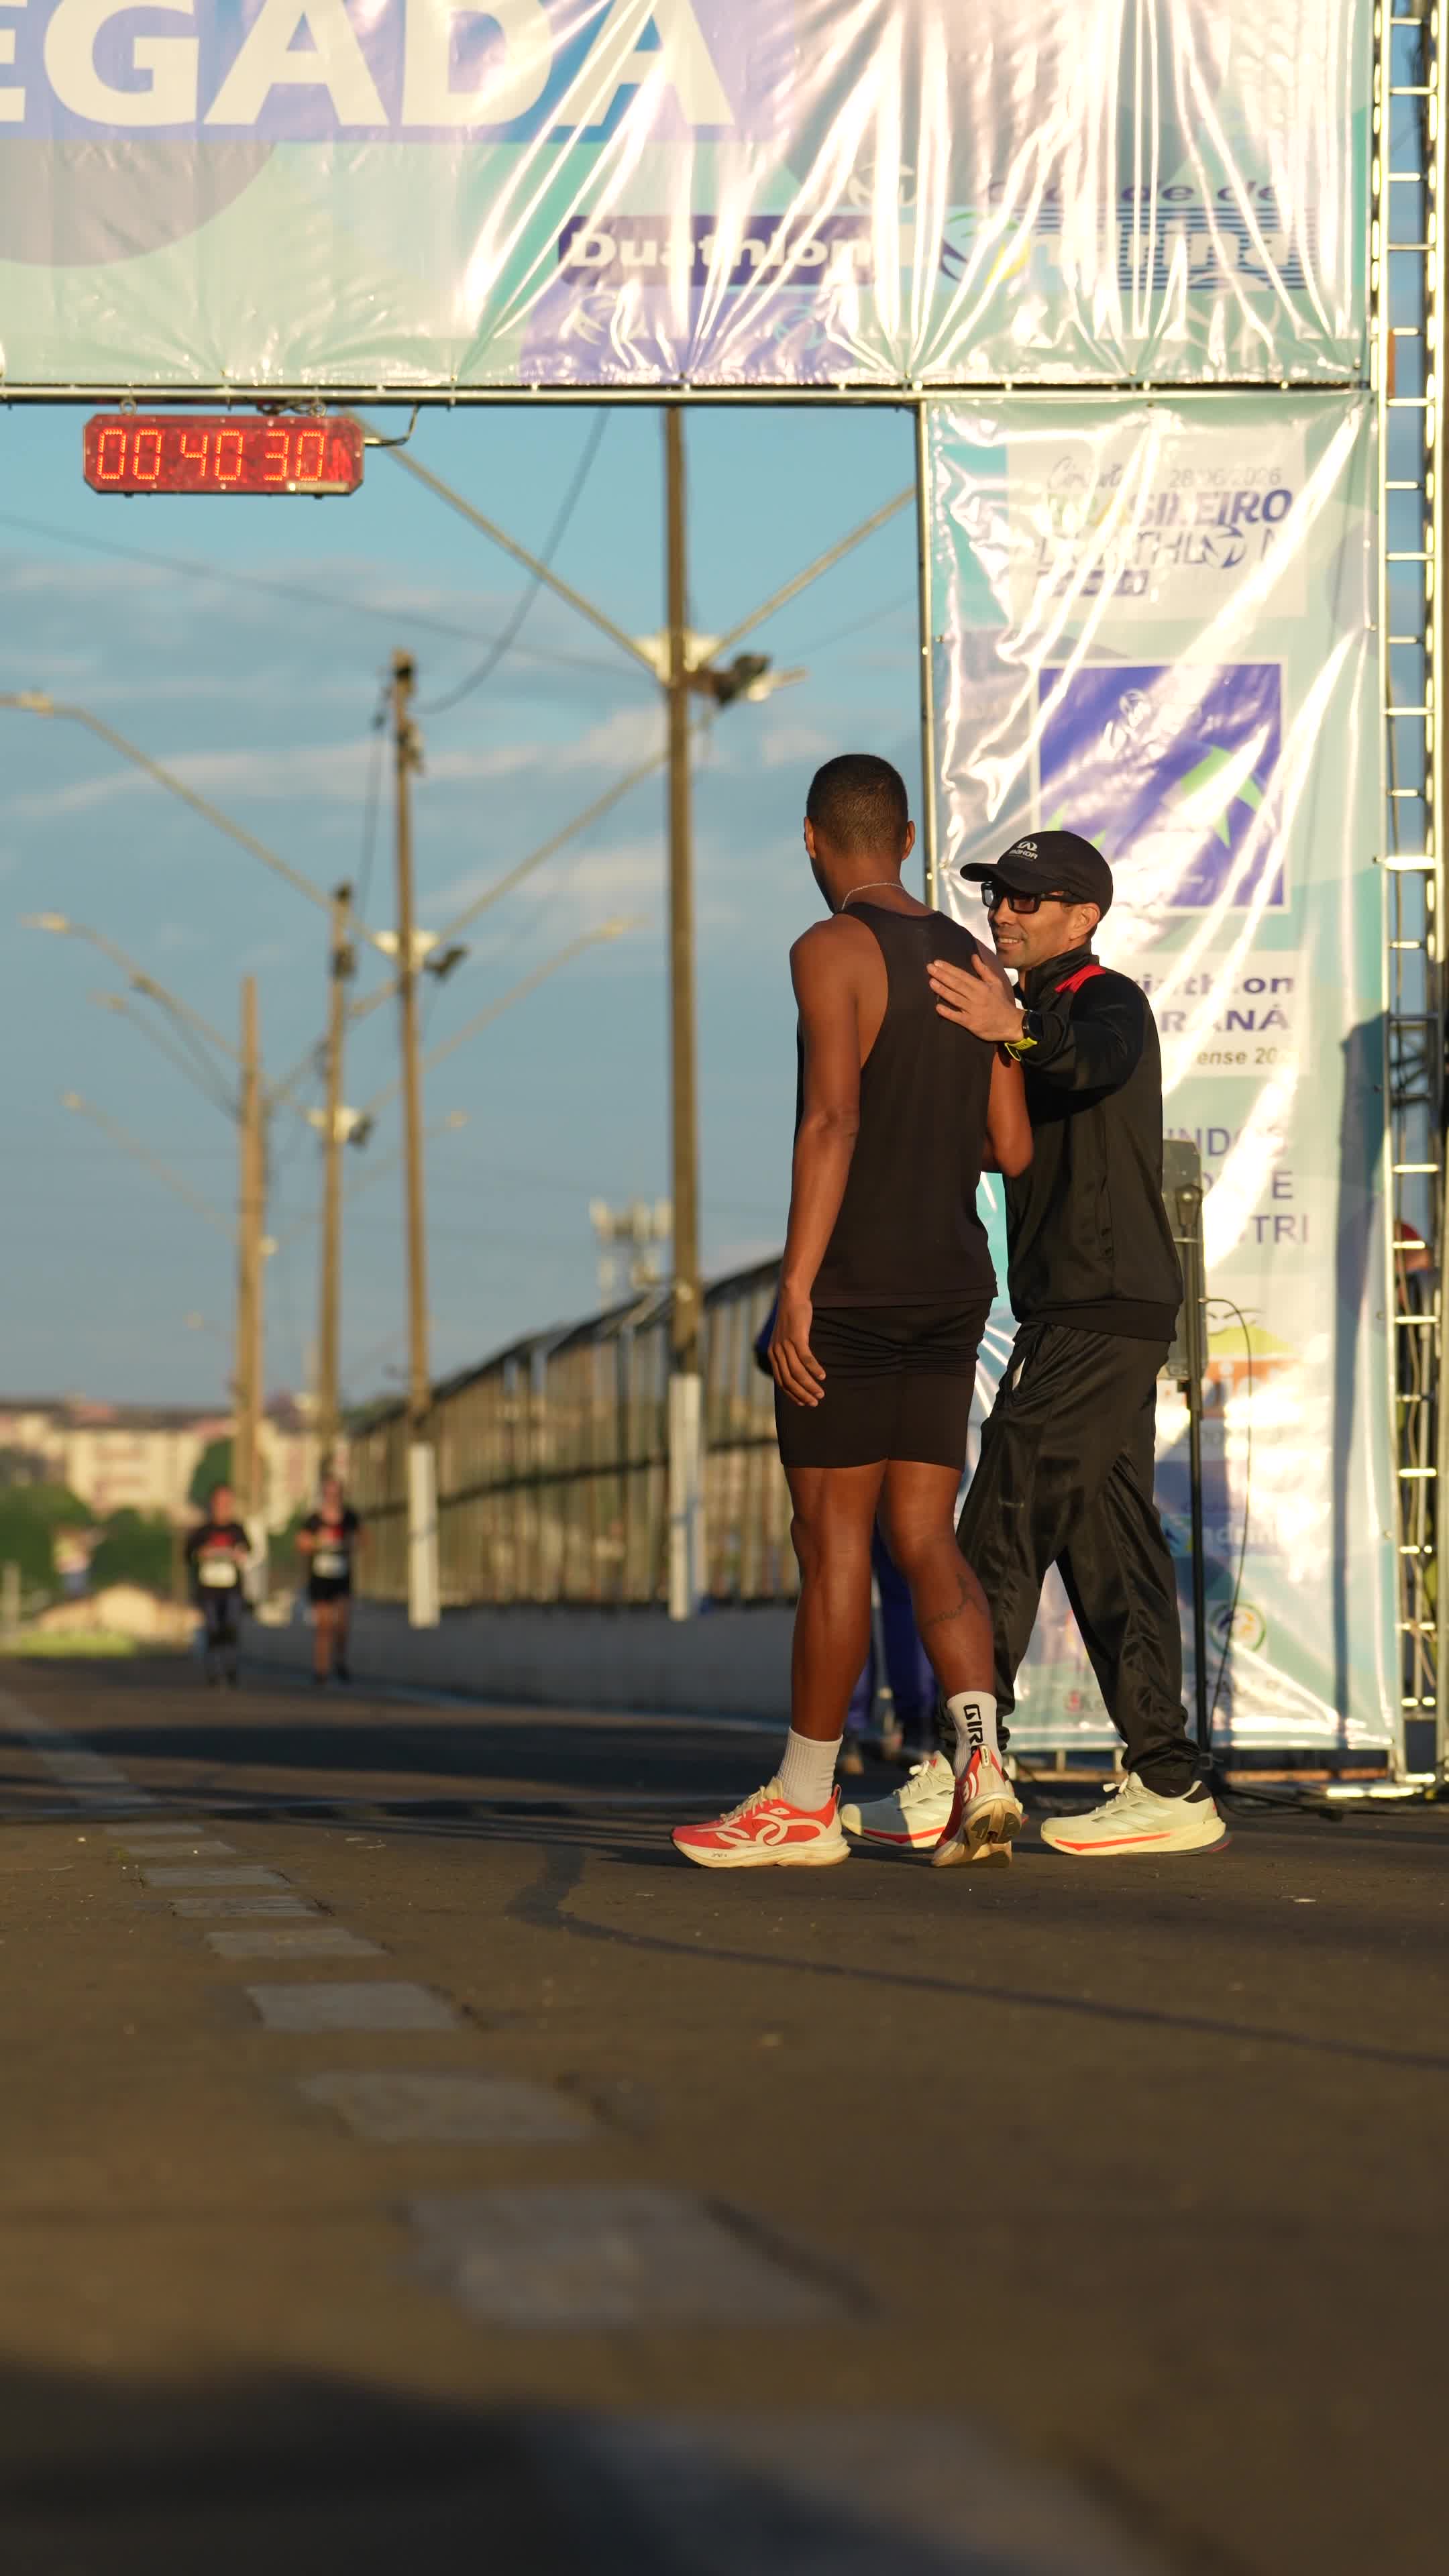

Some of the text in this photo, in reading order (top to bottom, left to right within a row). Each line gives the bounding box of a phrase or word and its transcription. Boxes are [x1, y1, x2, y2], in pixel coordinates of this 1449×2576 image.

[97, 429, 325, 482] 00 40 30
